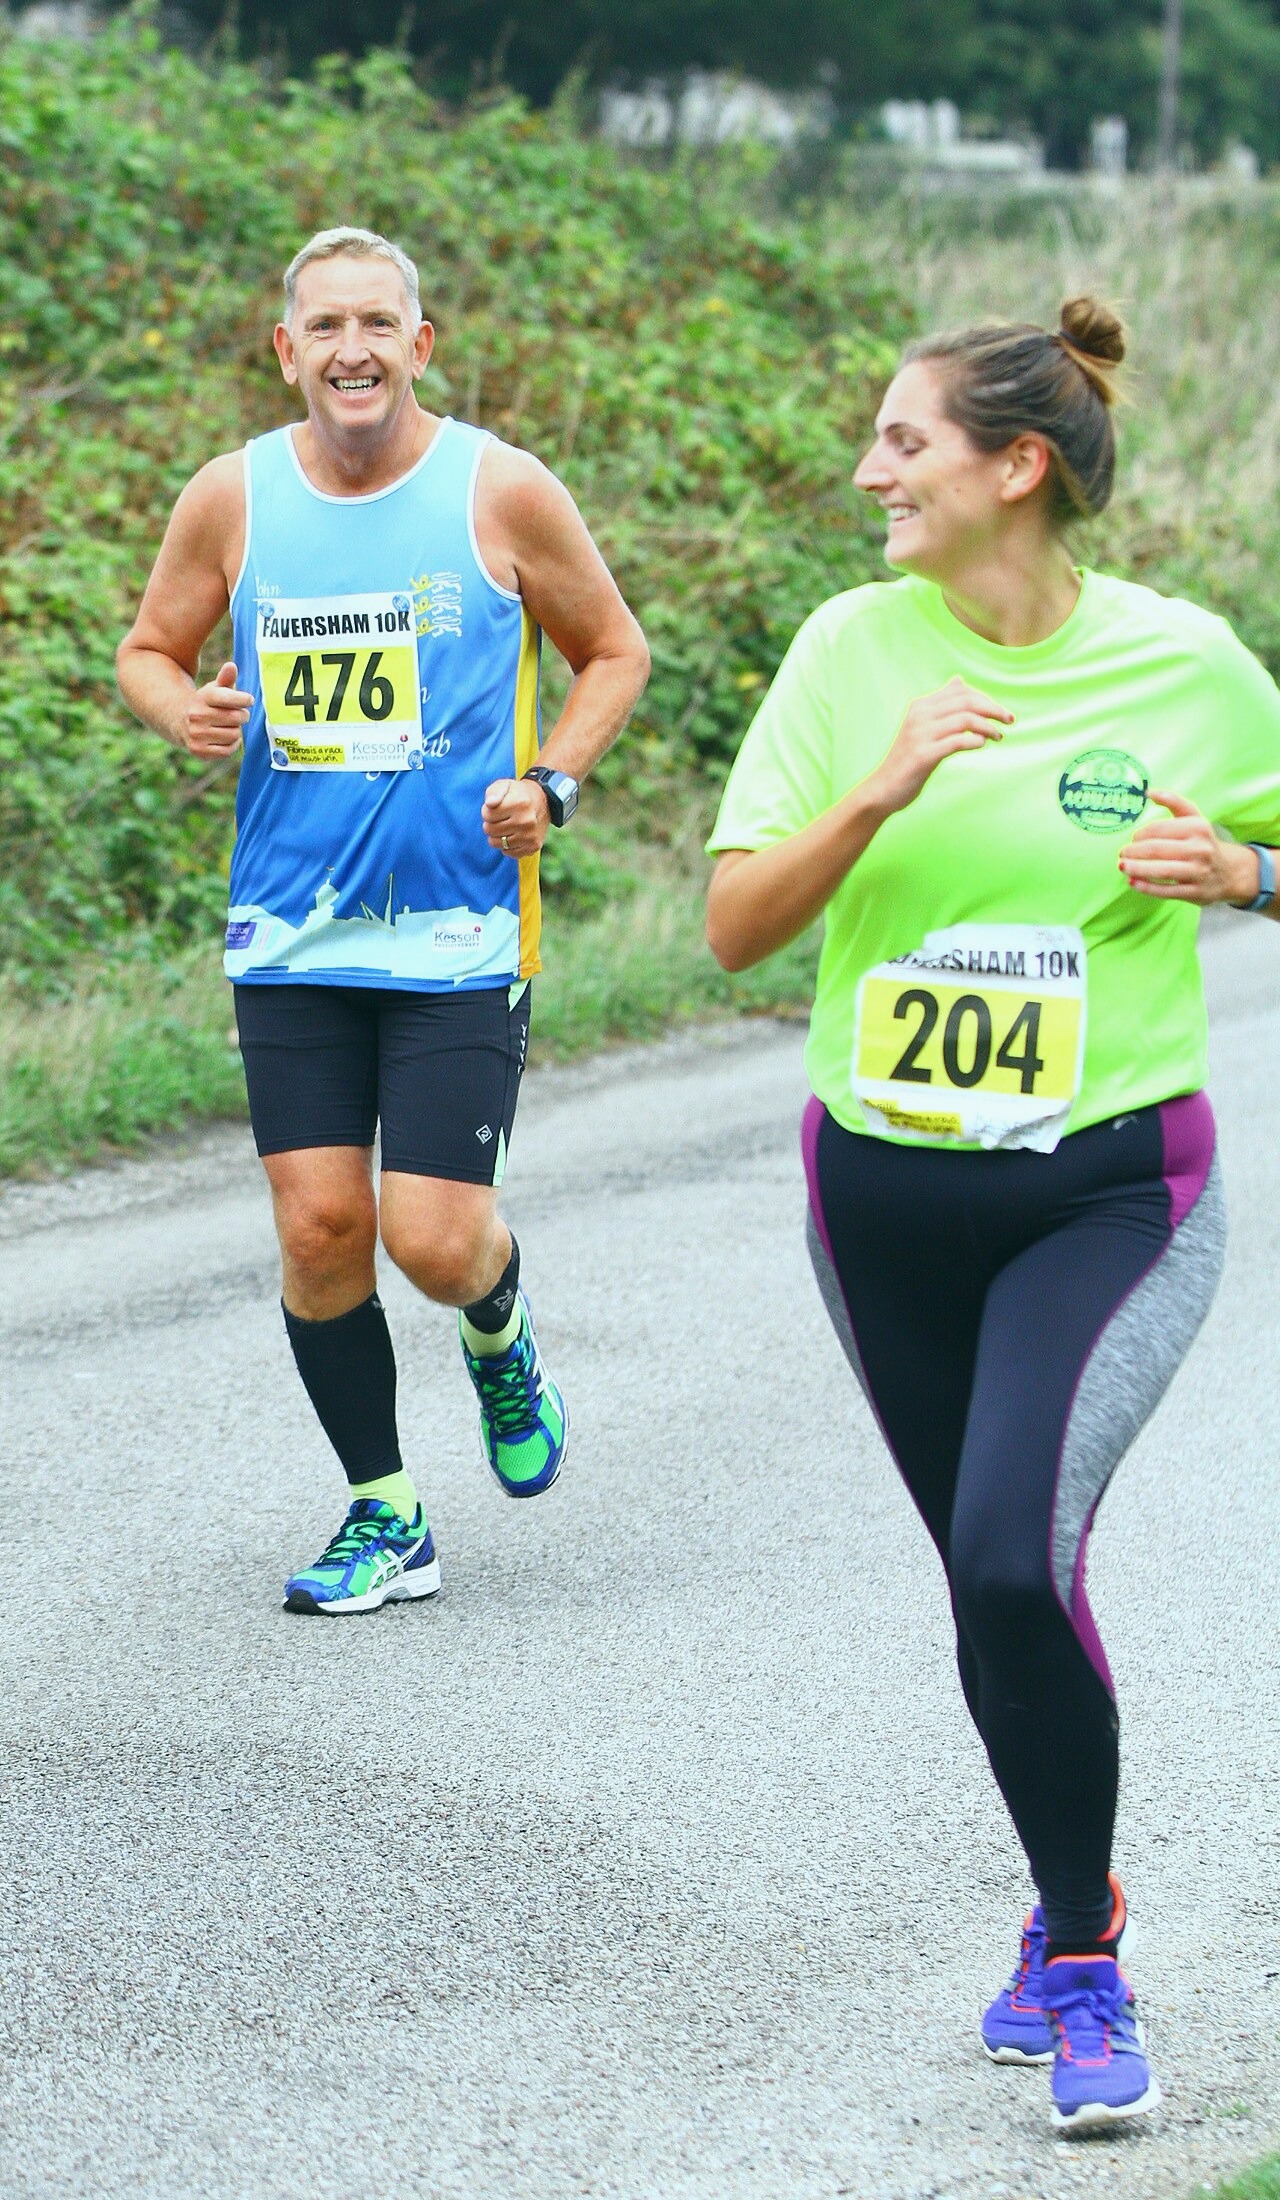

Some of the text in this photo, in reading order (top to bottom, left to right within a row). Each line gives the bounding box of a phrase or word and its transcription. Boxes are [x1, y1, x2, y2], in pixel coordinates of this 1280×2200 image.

[262, 611, 410, 638] FAVERSHAM 10K
[284, 652, 395, 722] 476
[352, 741, 406, 754] Kesson
[434, 931, 480, 943] Kesson
[1034, 950, 1080, 978] 10K
[888, 988, 1044, 1095] 204
